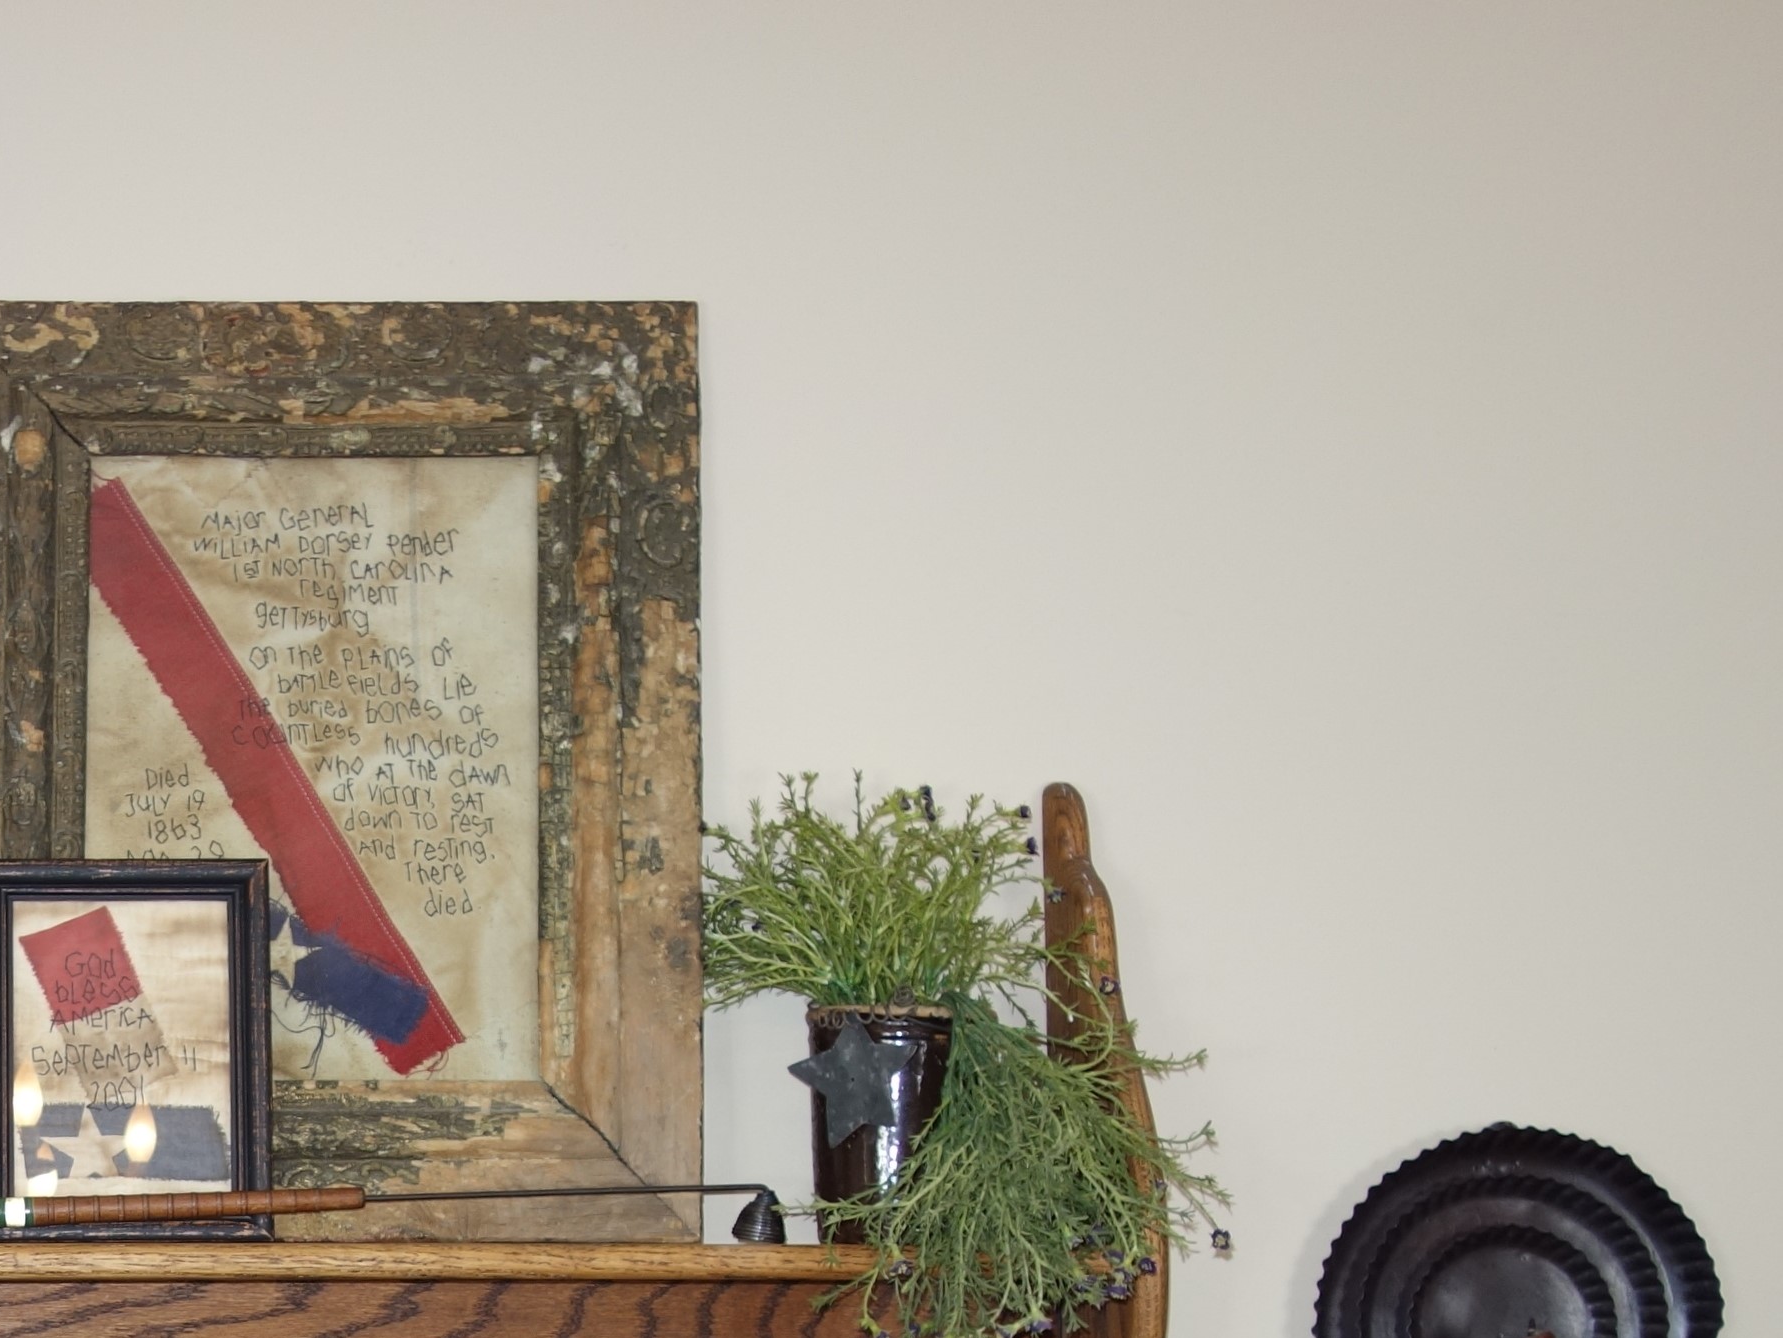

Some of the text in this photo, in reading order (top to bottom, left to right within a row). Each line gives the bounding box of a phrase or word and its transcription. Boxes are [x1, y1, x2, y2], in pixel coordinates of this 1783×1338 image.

[288, 699, 348, 720] buried
[366, 697, 443, 725] bones
[385, 728, 499, 760] hundreds
[145, 763, 190, 791] Died
[187, 789, 205, 812] 19
[148, 813, 202, 844] 1863
[344, 808, 402, 831] down
[183, 1045, 197, 1072] 11
